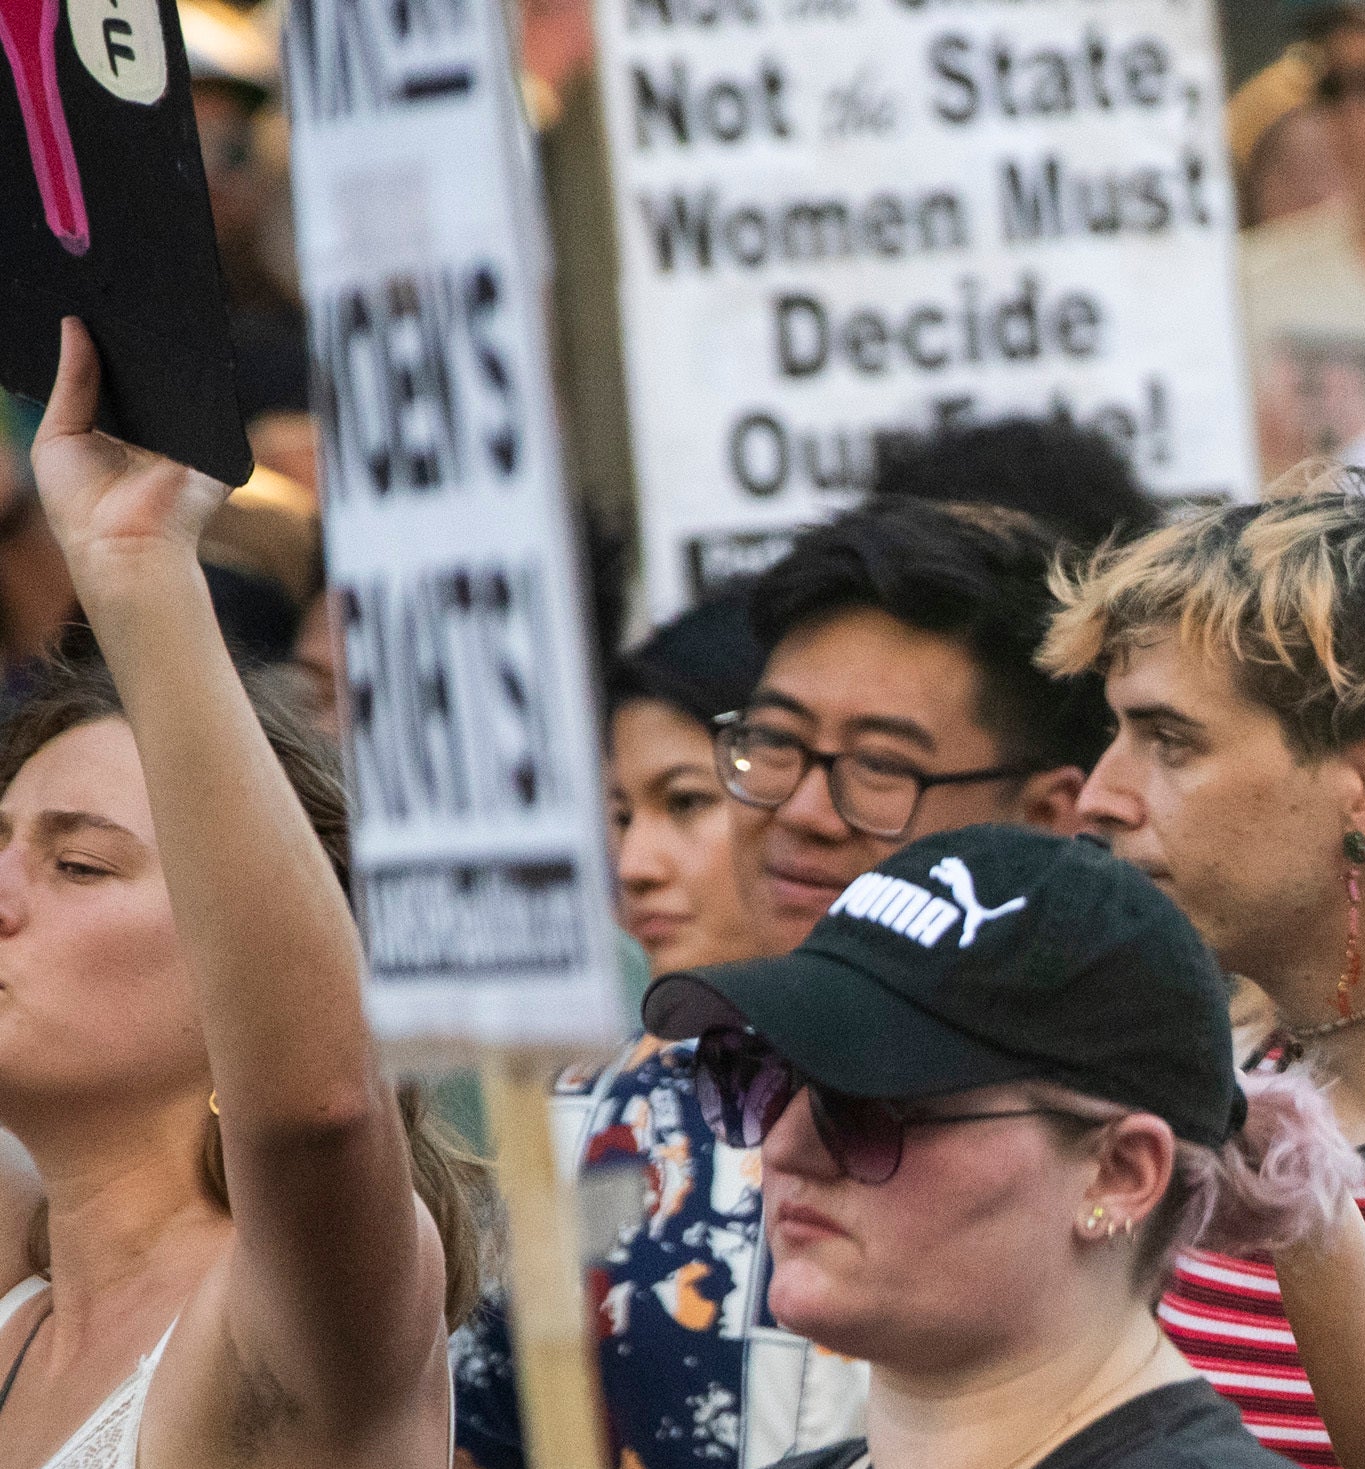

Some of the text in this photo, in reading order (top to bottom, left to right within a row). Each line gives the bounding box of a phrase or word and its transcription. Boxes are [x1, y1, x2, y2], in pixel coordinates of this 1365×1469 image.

[630, 62, 790, 147] Not
[926, 25, 1204, 125] State,
[640, 145, 1214, 272] Women Must
[774, 268, 1104, 381] Decide
[828, 871, 962, 948] PUMA
